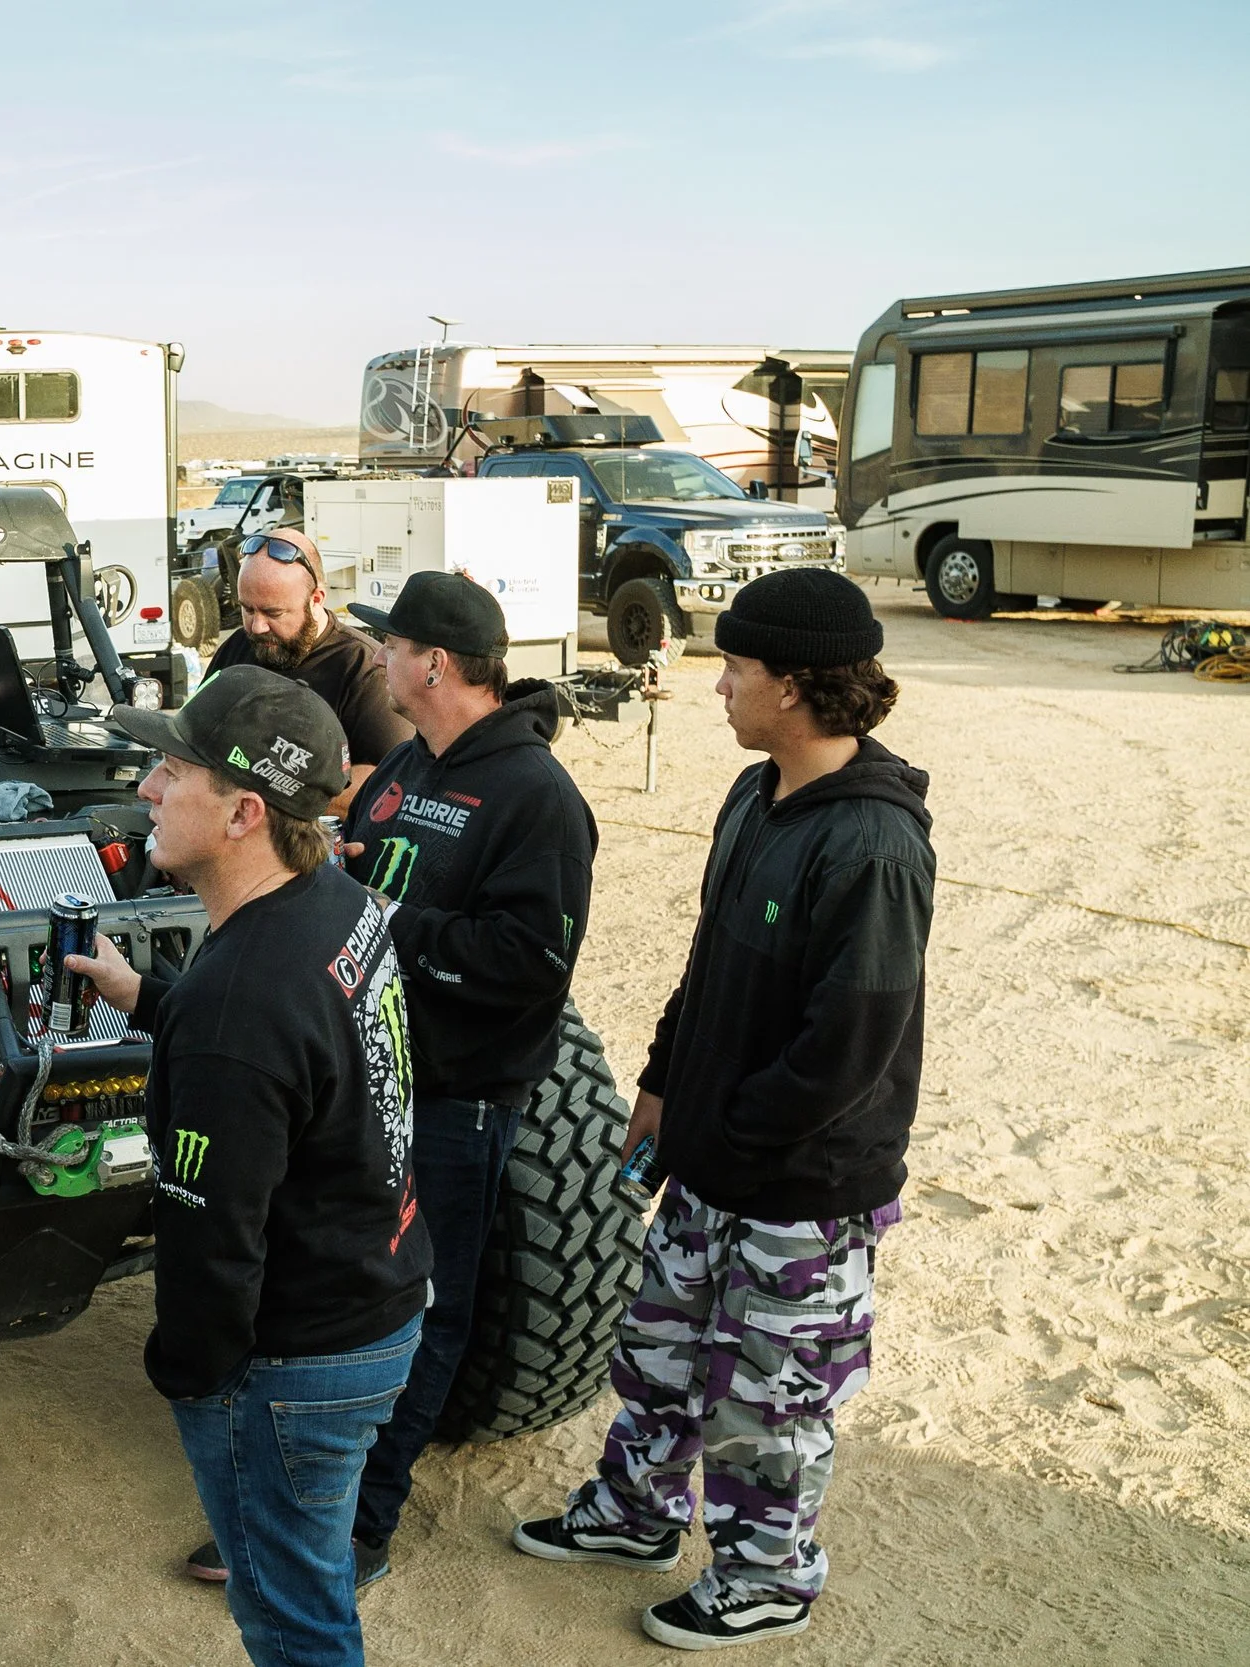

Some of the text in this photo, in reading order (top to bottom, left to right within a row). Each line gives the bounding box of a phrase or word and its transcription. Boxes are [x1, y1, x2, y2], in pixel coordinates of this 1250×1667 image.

[269, 735, 314, 776] FOX
[251, 757, 305, 792] CURRIE
[268, 781, 295, 797] RACING
[401, 794, 471, 829] CURRIE
[403, 815, 448, 833] ENTERPRISES
[359, 921, 388, 974] ENTERPRISE
[428, 965, 463, 984] CURRIE
[159, 1181, 206, 1208] MONSTER
